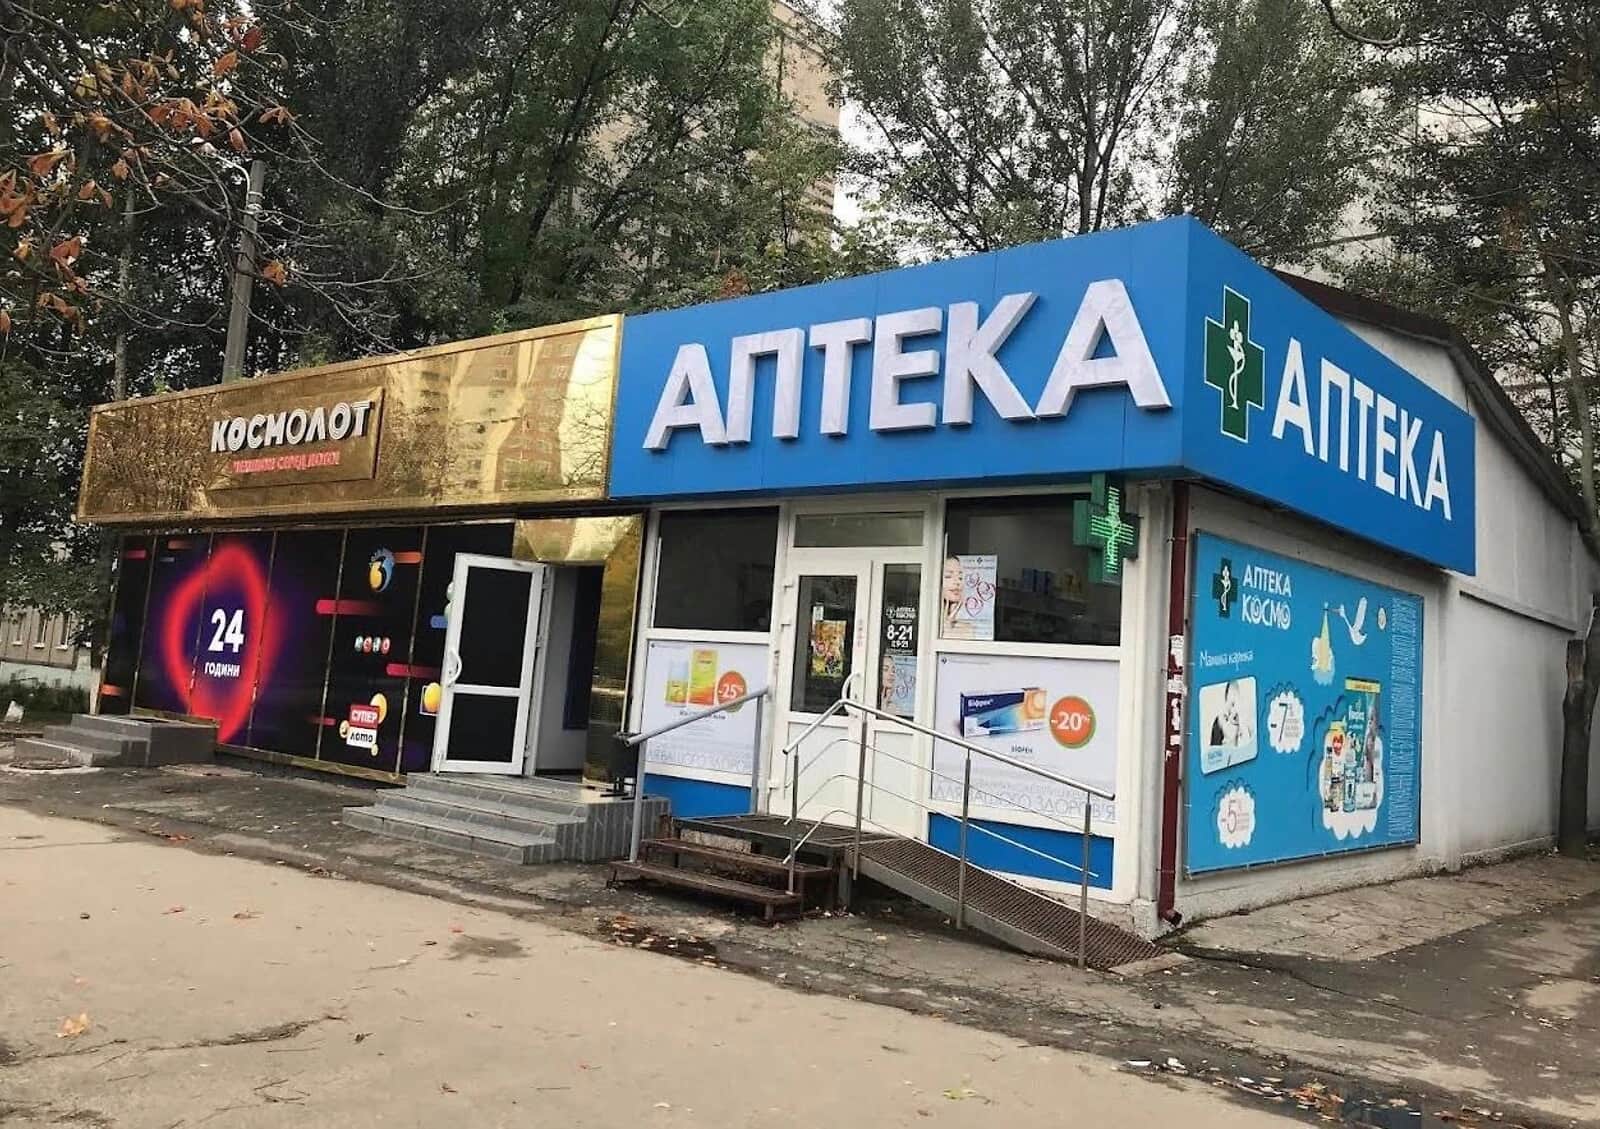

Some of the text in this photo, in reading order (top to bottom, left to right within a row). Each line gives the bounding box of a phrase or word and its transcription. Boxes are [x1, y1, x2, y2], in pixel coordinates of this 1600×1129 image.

[642, 278, 1173, 450] АПТЕКА
[211, 400, 372, 452] КОСМОЛОТ
[1271, 336, 1452, 521] АПТЕКА
[1242, 564, 1292, 598] АПТЕКА
[208, 608, 245, 653] 24
[1241, 594, 1291, 630] КОСМО
[887, 625, 913, 640] 8-21
[204, 662, 241, 677] ГОДИНИ
